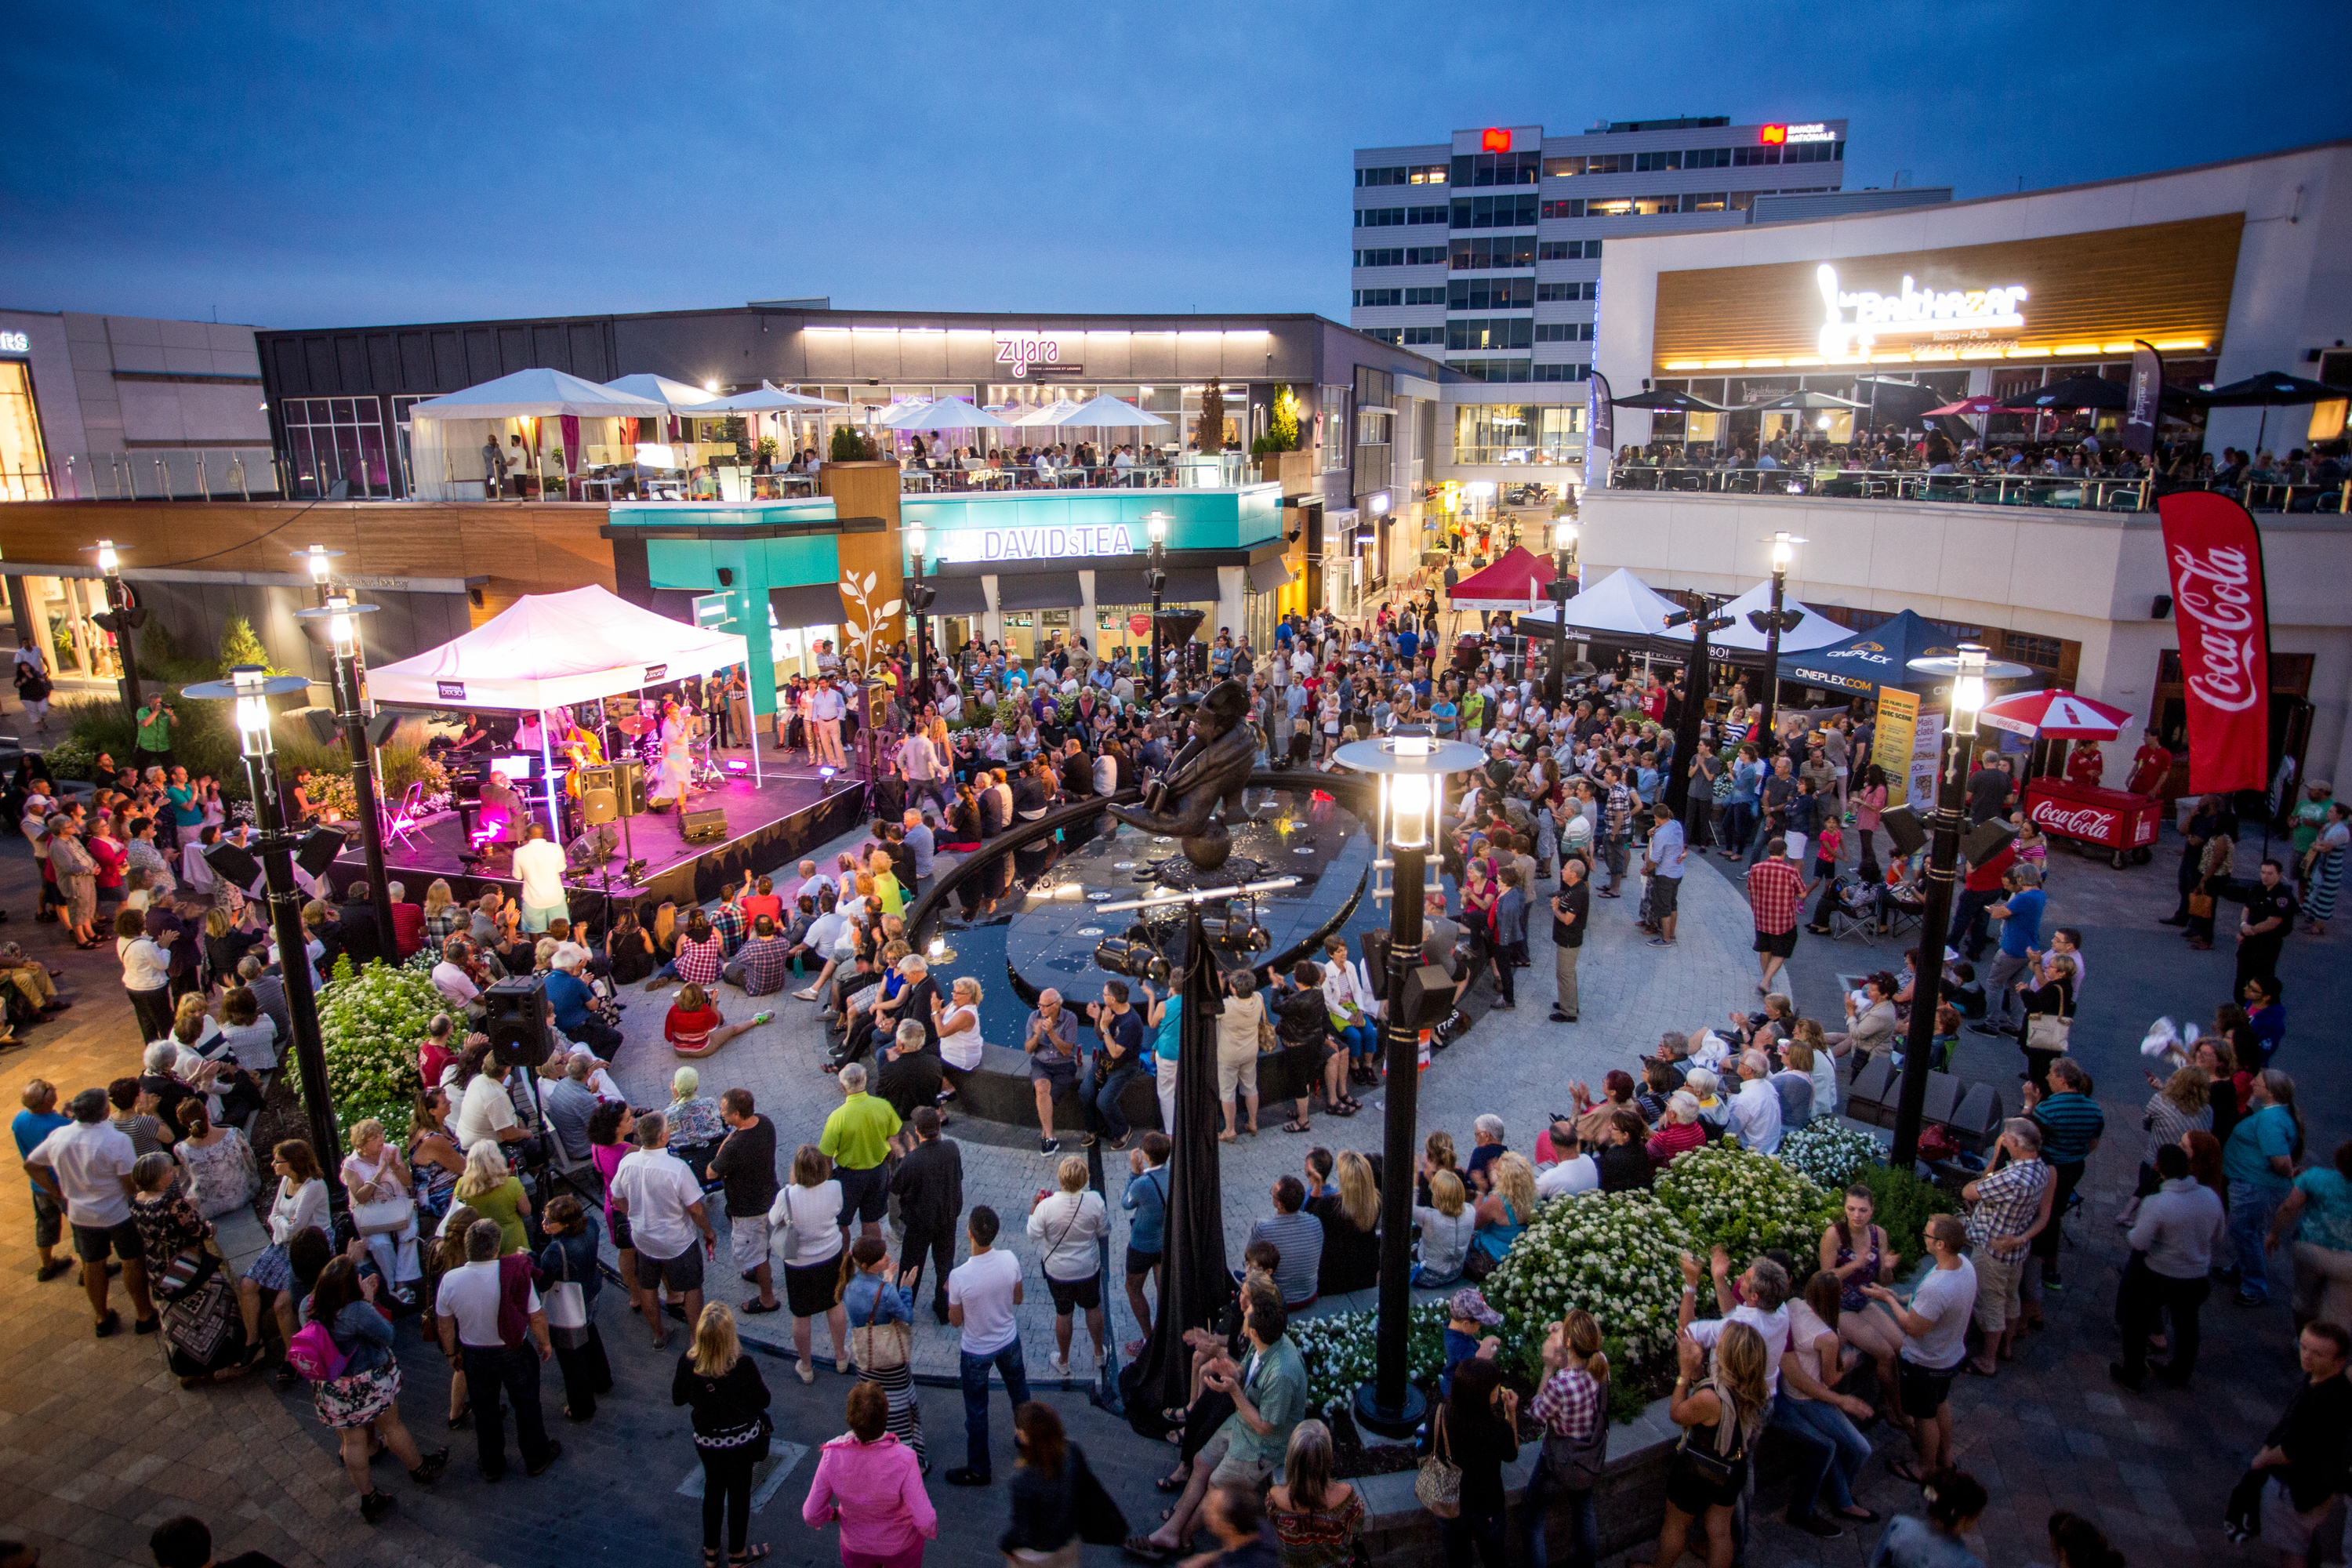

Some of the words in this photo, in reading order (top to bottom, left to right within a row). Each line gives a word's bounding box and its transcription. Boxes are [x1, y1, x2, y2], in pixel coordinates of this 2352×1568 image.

[1787, 132, 1835, 143] NATIONALE
[1788, 124, 1824, 134] BANQUE
[2173, 543, 2257, 712] Coca-Cola
[1827, 649, 1892, 664] CINEPLEX
[1795, 668, 1871, 691] CINEPLEX.COM
[2031, 800, 2115, 838] Coca-Cola
